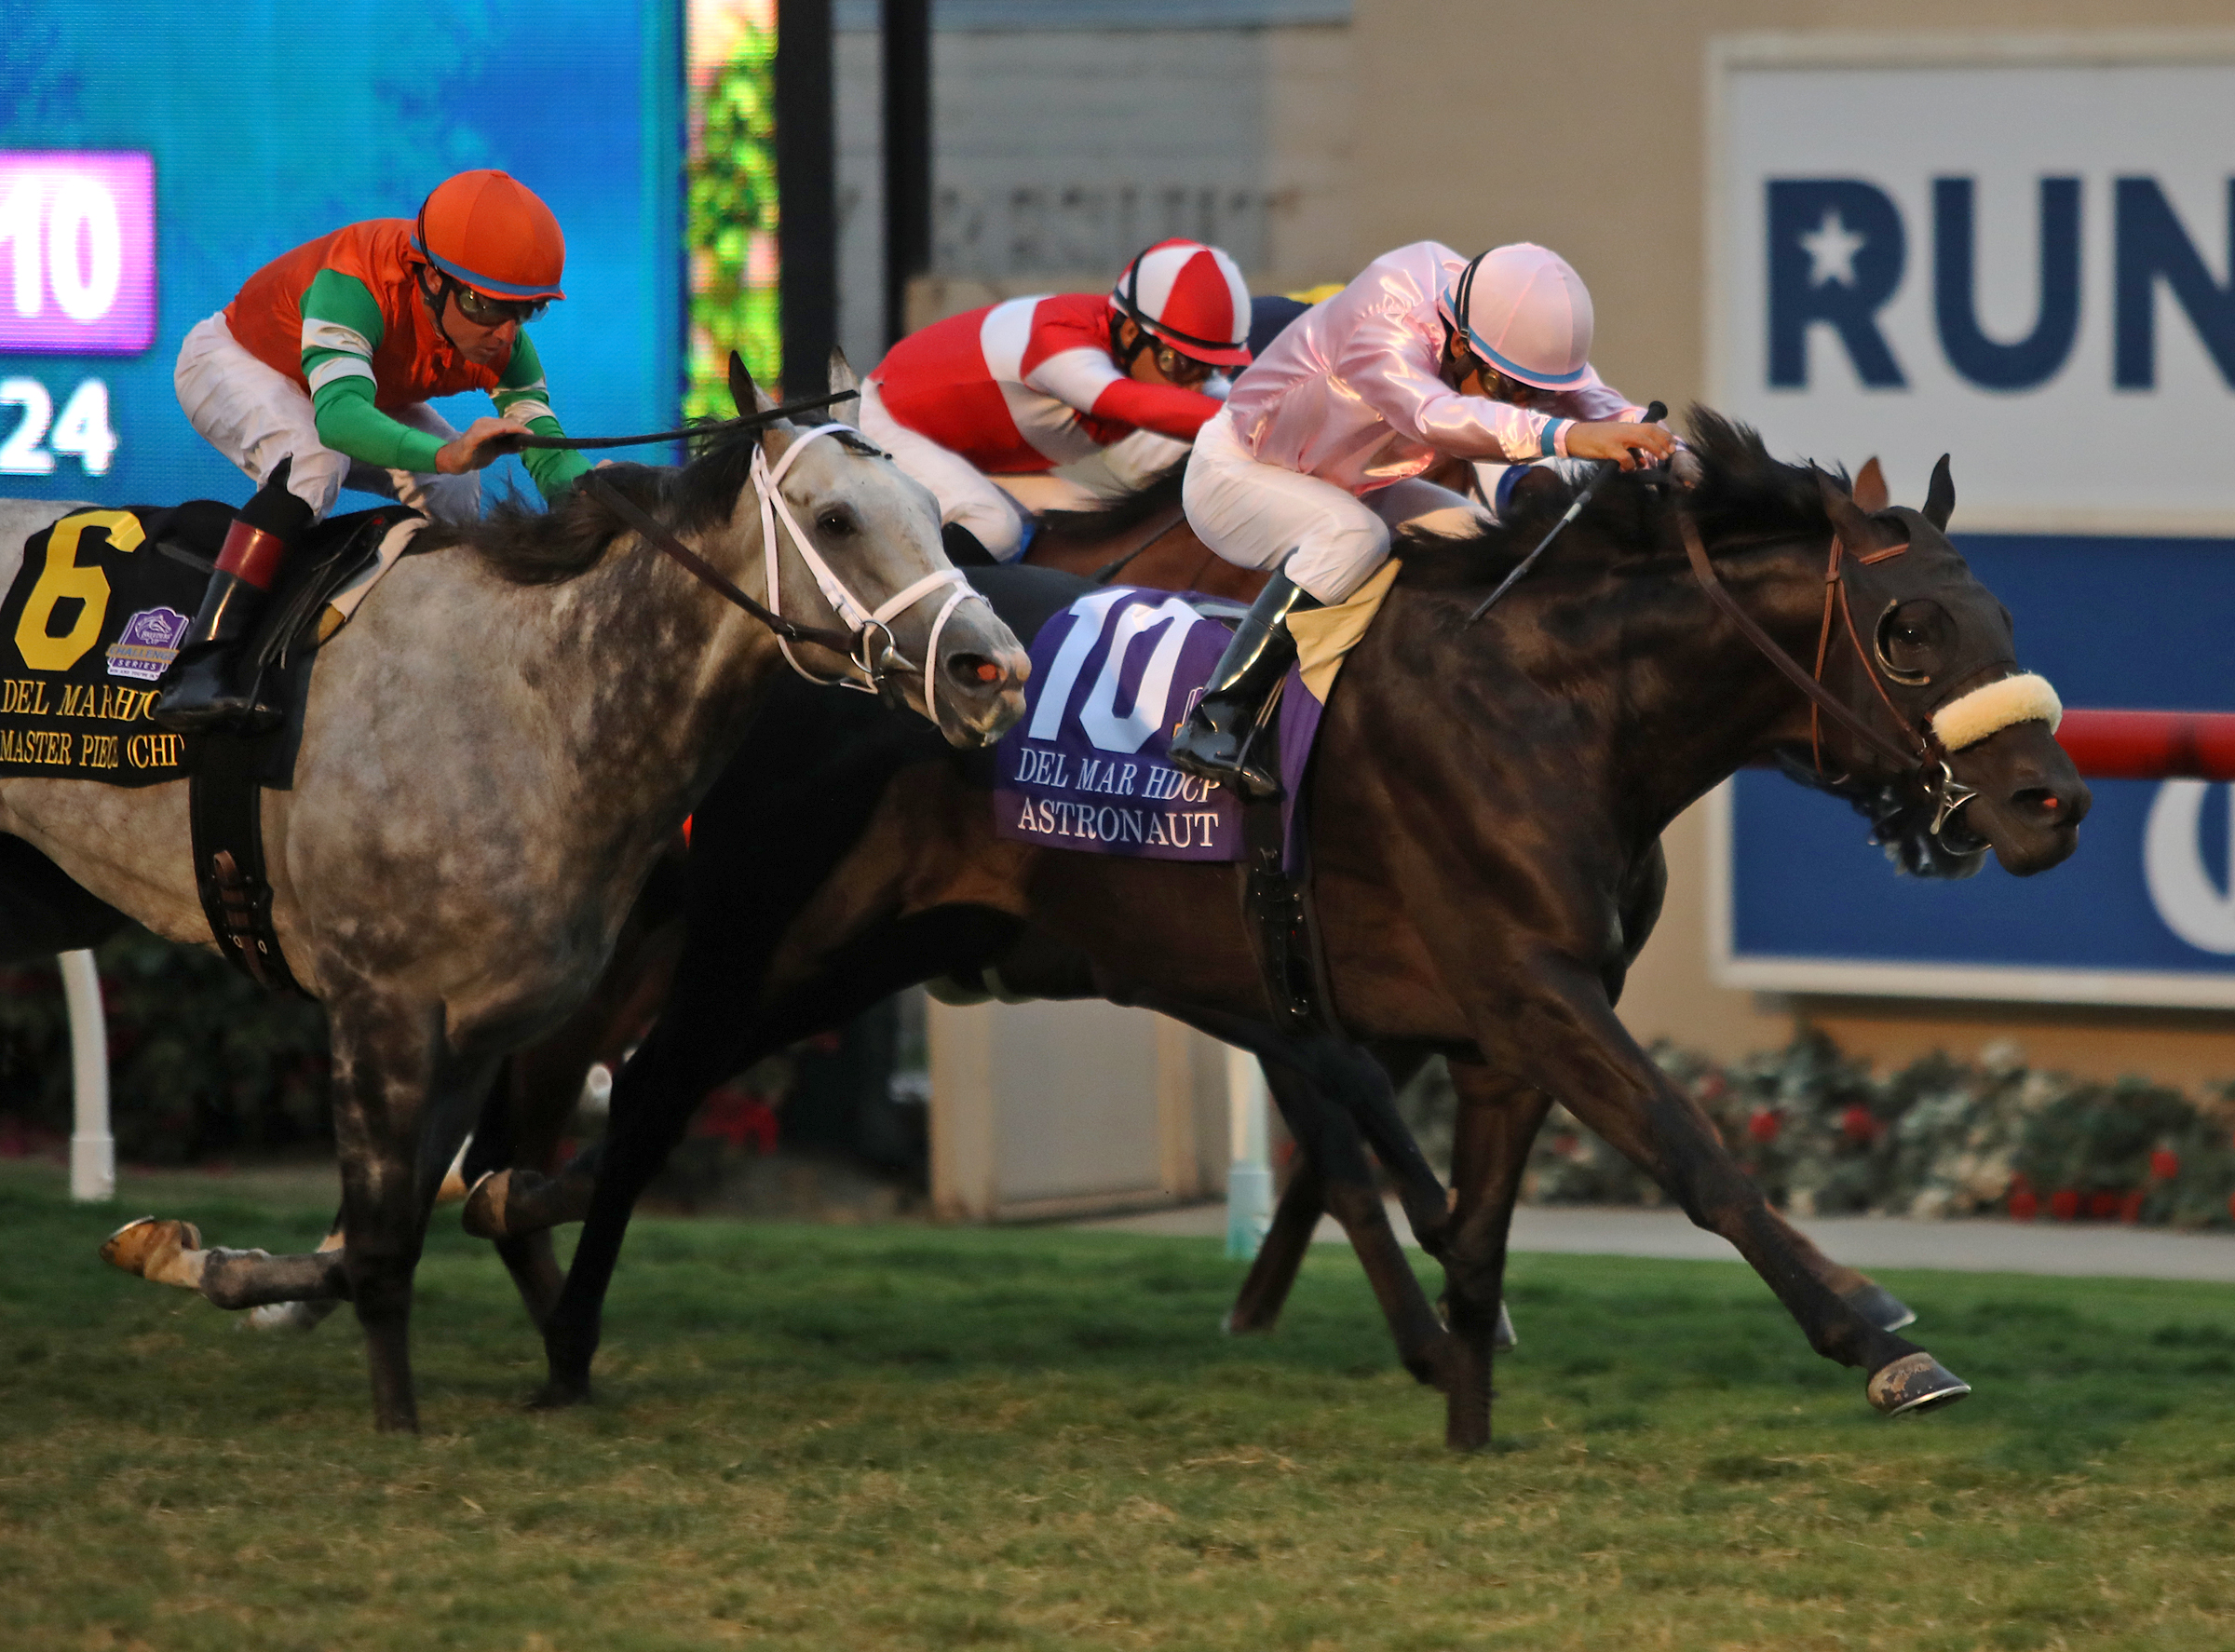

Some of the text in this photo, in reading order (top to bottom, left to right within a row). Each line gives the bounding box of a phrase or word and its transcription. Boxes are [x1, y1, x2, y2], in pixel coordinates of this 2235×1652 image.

[0, 173, 121, 323] 10
[1765, 175, 2235, 395] RUN
[0, 377, 117, 476] 24
[14, 510, 146, 671] 6
[110, 646, 177, 661] CHALLENGE
[117, 659, 157, 670] SERIES
[1028, 589, 1205, 754] 10
[0, 679, 50, 715] DEL
[56, 684, 114, 719] MAR
[0, 729, 73, 765] MASTER
[79, 734, 119, 769] PIEC
[1014, 748, 1220, 803] DEL MAR HDCP
[1018, 797, 1219, 848] ASTRONAUT
